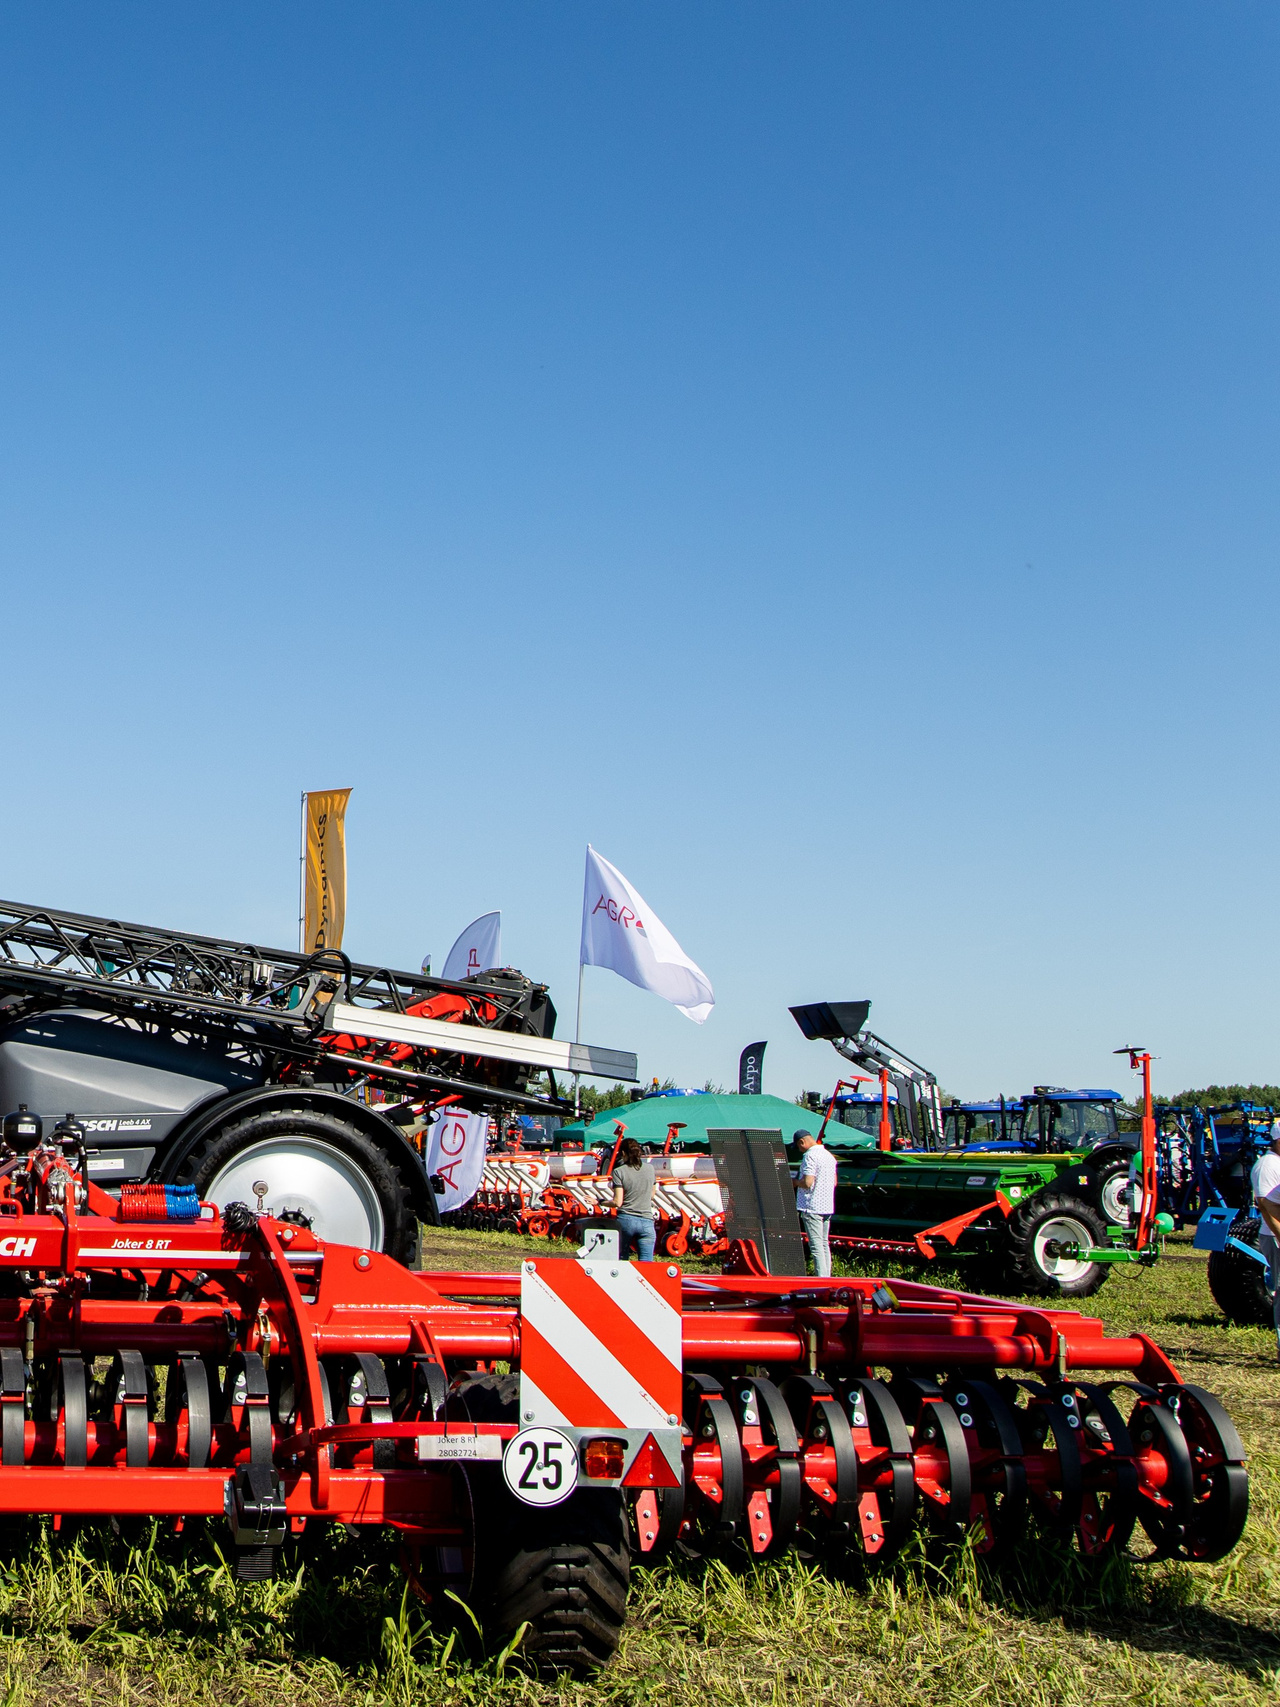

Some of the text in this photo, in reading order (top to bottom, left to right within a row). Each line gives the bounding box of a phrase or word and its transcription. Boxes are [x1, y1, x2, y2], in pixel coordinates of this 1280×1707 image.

[315, 813, 328, 949] Dynamics
[111, 1238, 172, 1250] Joker 8 RT
[437, 1435, 477, 1444] Joker 8 RT
[438, 1449, 477, 1457] 28082724
[518, 1440, 563, 1491] 25
